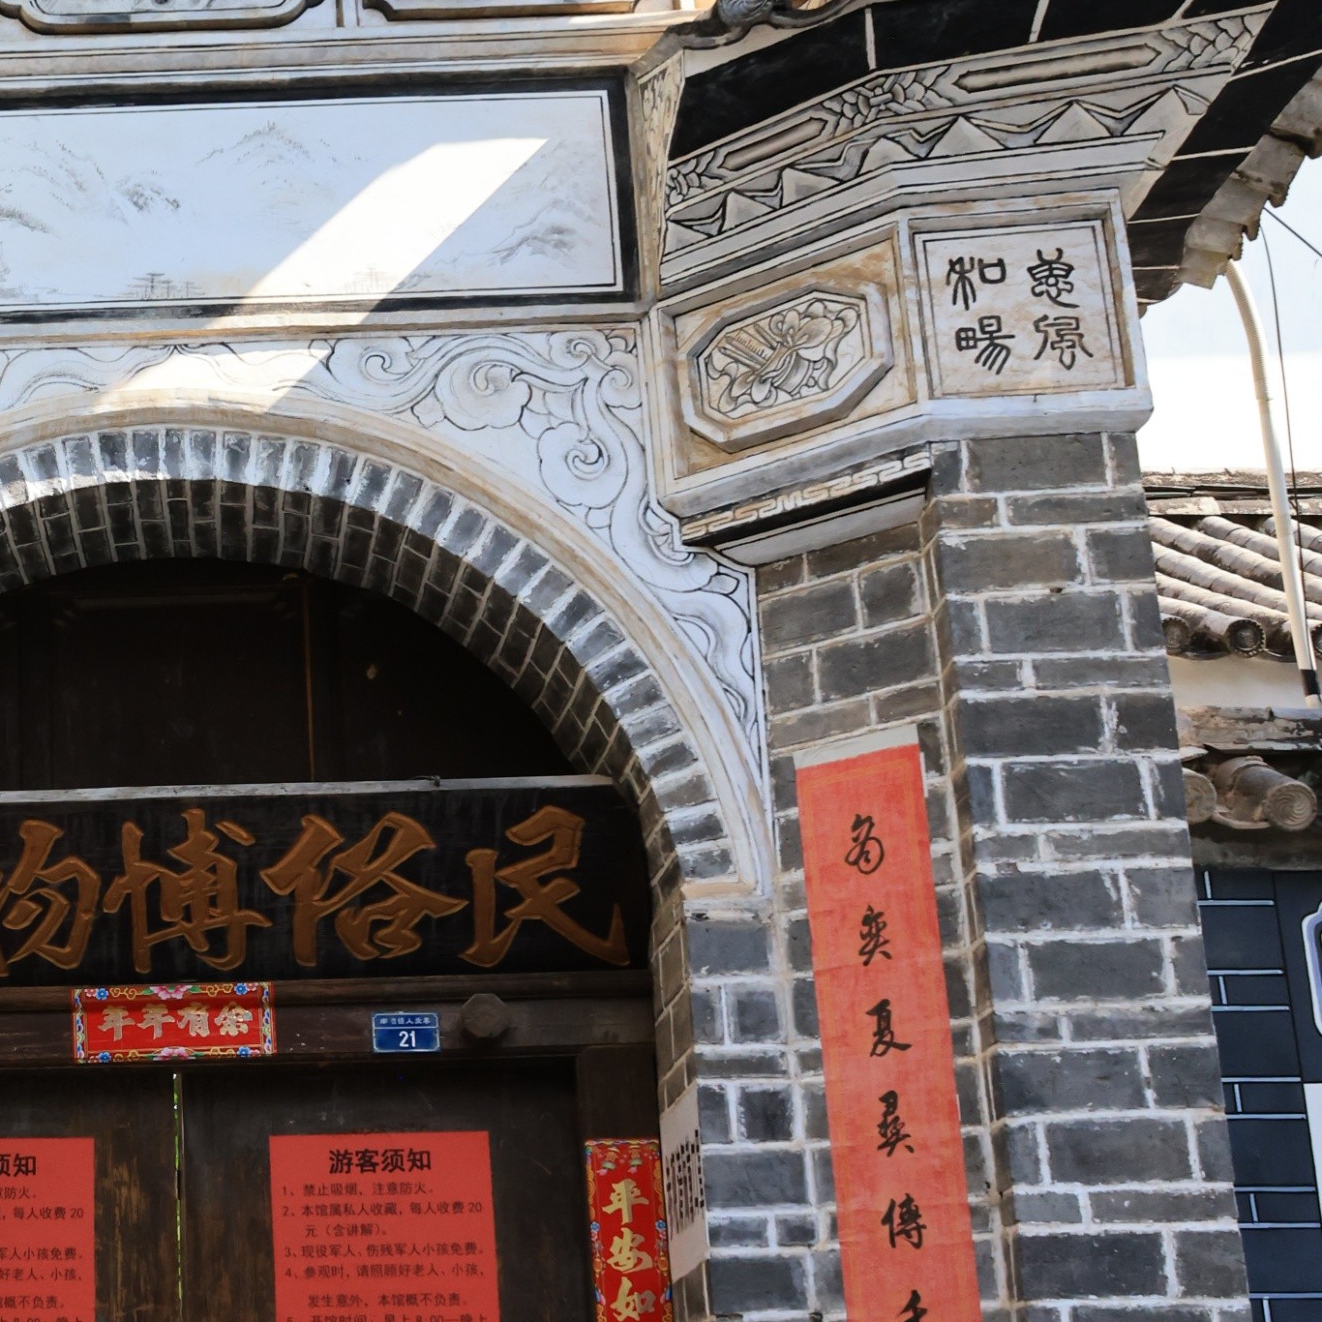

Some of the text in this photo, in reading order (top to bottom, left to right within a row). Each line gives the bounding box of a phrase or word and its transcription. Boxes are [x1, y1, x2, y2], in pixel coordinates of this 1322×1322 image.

[399, 1030, 416, 1047] 21
[329, 1148, 431, 1174] 游客须知
